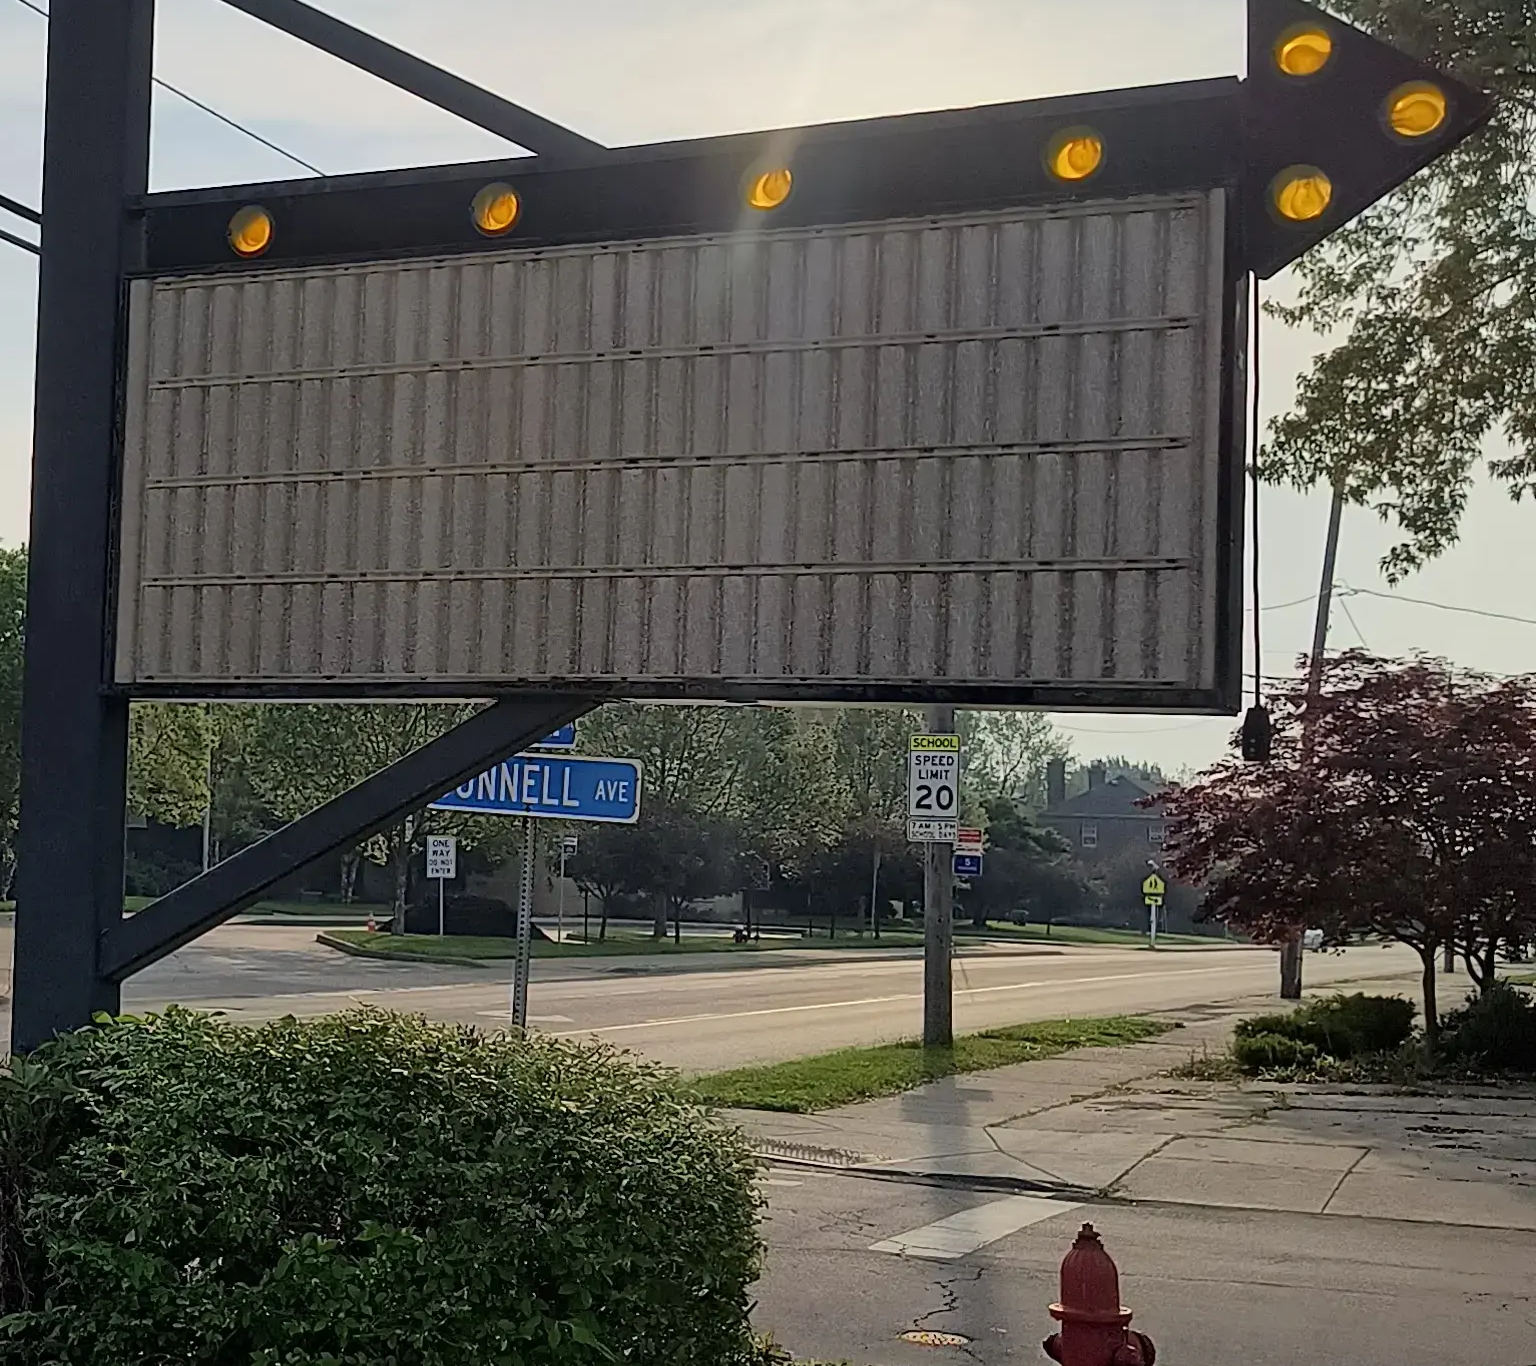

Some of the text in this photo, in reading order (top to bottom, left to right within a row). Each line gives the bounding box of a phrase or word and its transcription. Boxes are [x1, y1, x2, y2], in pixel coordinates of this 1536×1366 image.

[913, 737, 957, 748] SCHOOL
[915, 755, 954, 766] SPEED
[918, 769, 950, 780] LIMIT
[442, 762, 629, 807] NNELL AVE
[915, 784, 954, 811] 20
[432, 839, 450, 848] ONE
[432, 849, 451, 857] WAY
